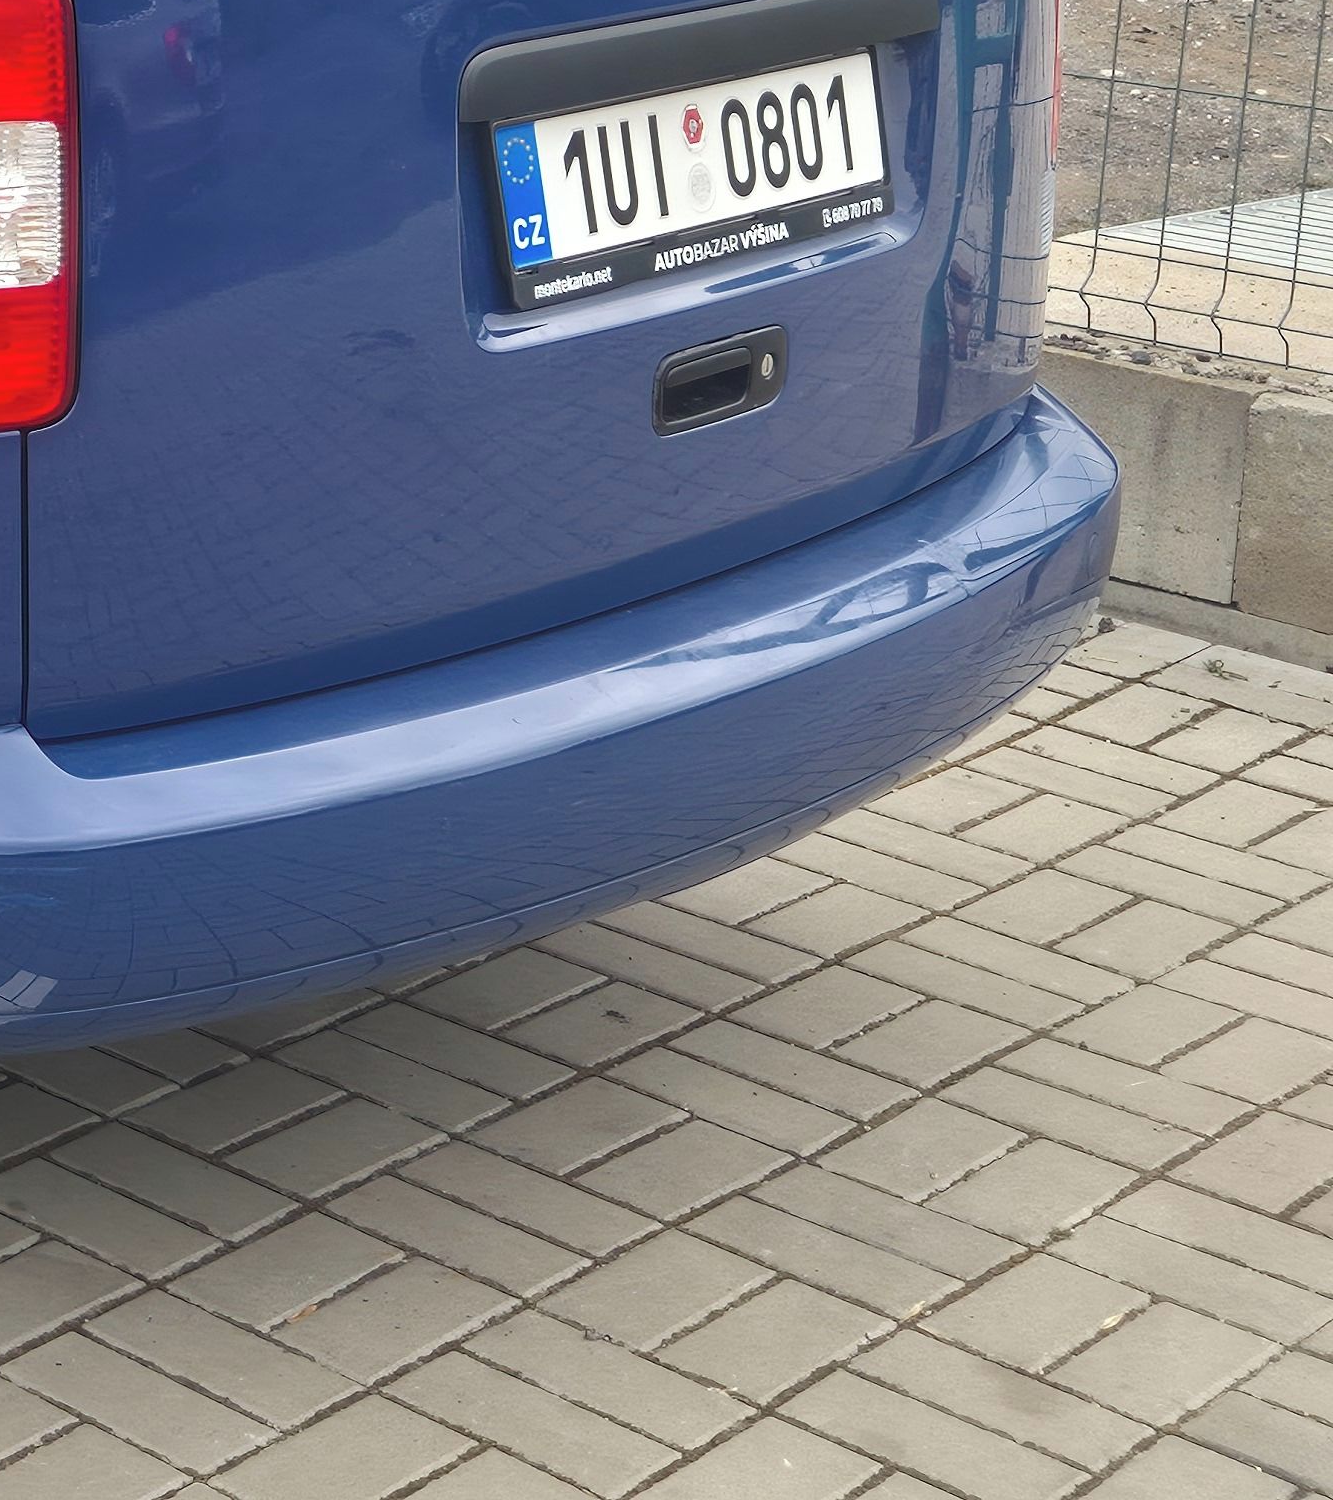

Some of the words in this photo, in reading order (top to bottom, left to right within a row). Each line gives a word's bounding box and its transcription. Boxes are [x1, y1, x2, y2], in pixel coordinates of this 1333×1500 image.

[563, 113, 670, 235] 1UI
[720, 74, 854, 198] 0801
[513, 214, 546, 250] CZ
[654, 234, 739, 272] AUTOBAZAR
[739, 221, 790, 250] VÝŠINA
